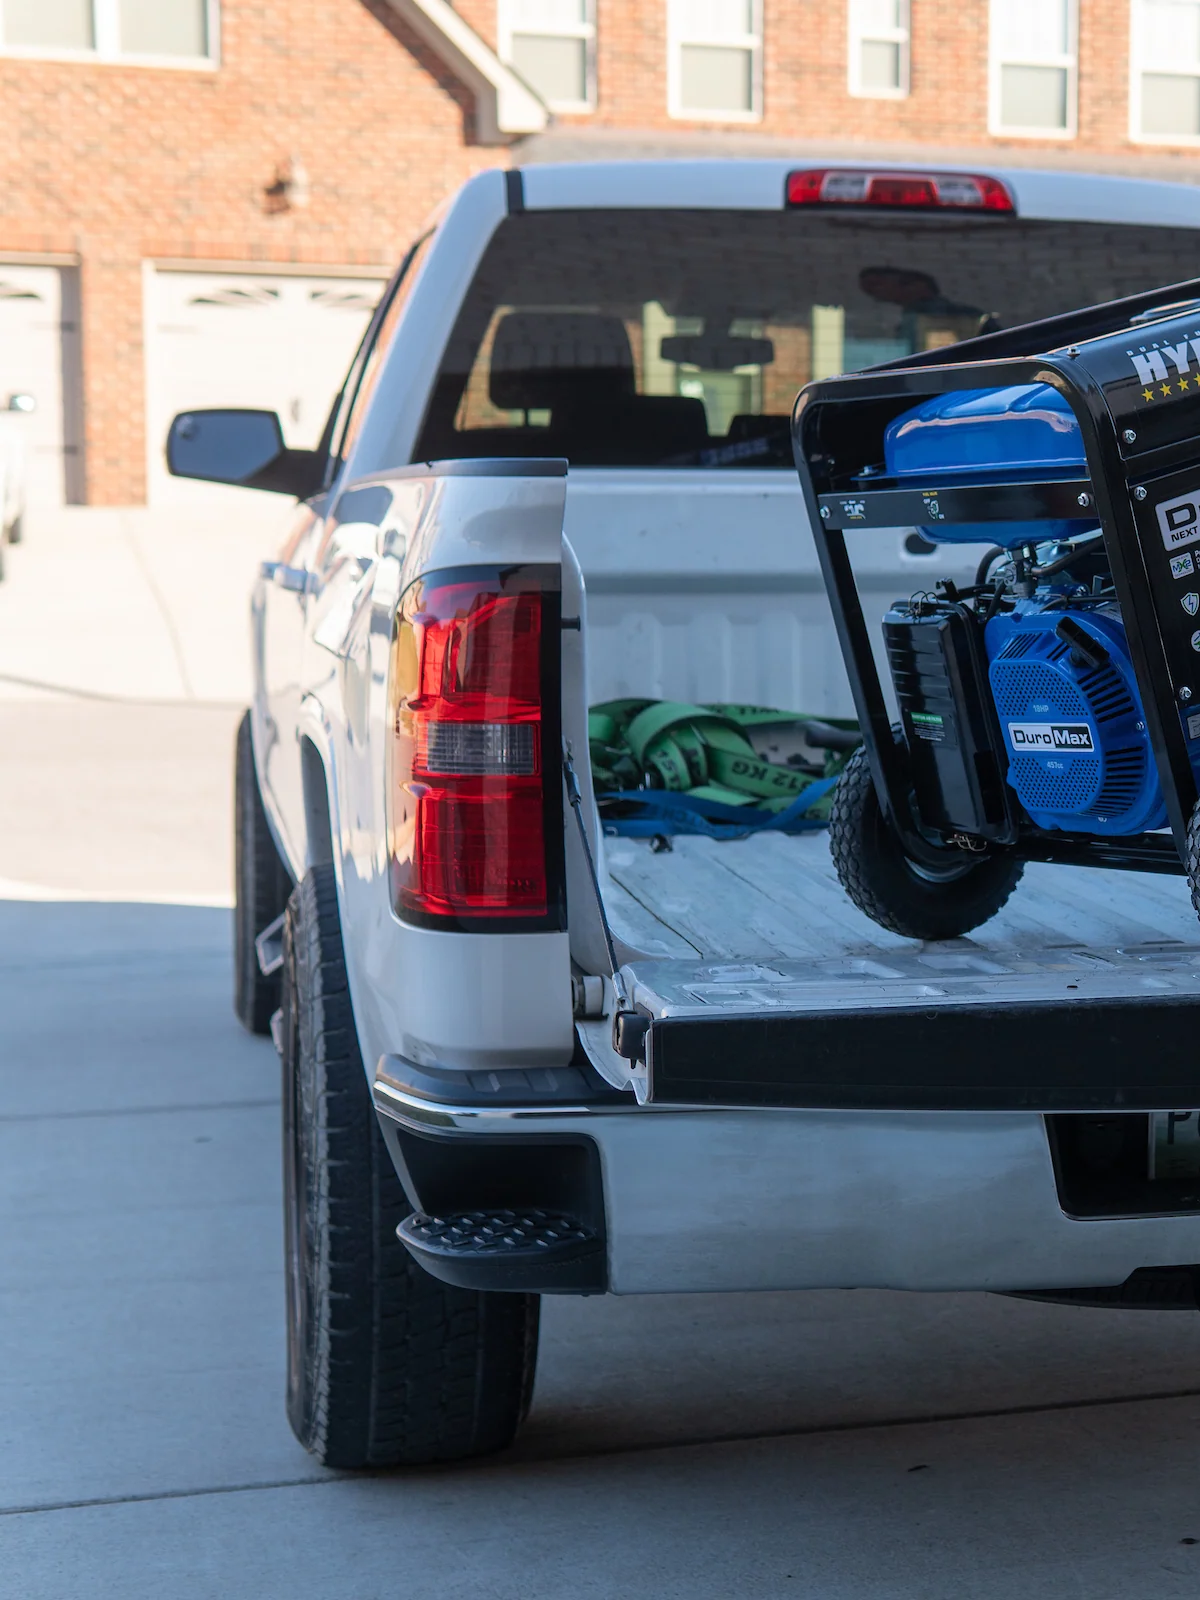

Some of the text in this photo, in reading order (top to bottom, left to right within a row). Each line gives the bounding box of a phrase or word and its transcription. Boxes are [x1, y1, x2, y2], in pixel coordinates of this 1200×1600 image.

[1126, 340, 1170, 356] DUAL
[1170, 524, 1199, 542] NEXT
[1012, 729, 1091, 745] DuroMax
[731, 760, 769, 781] KG
